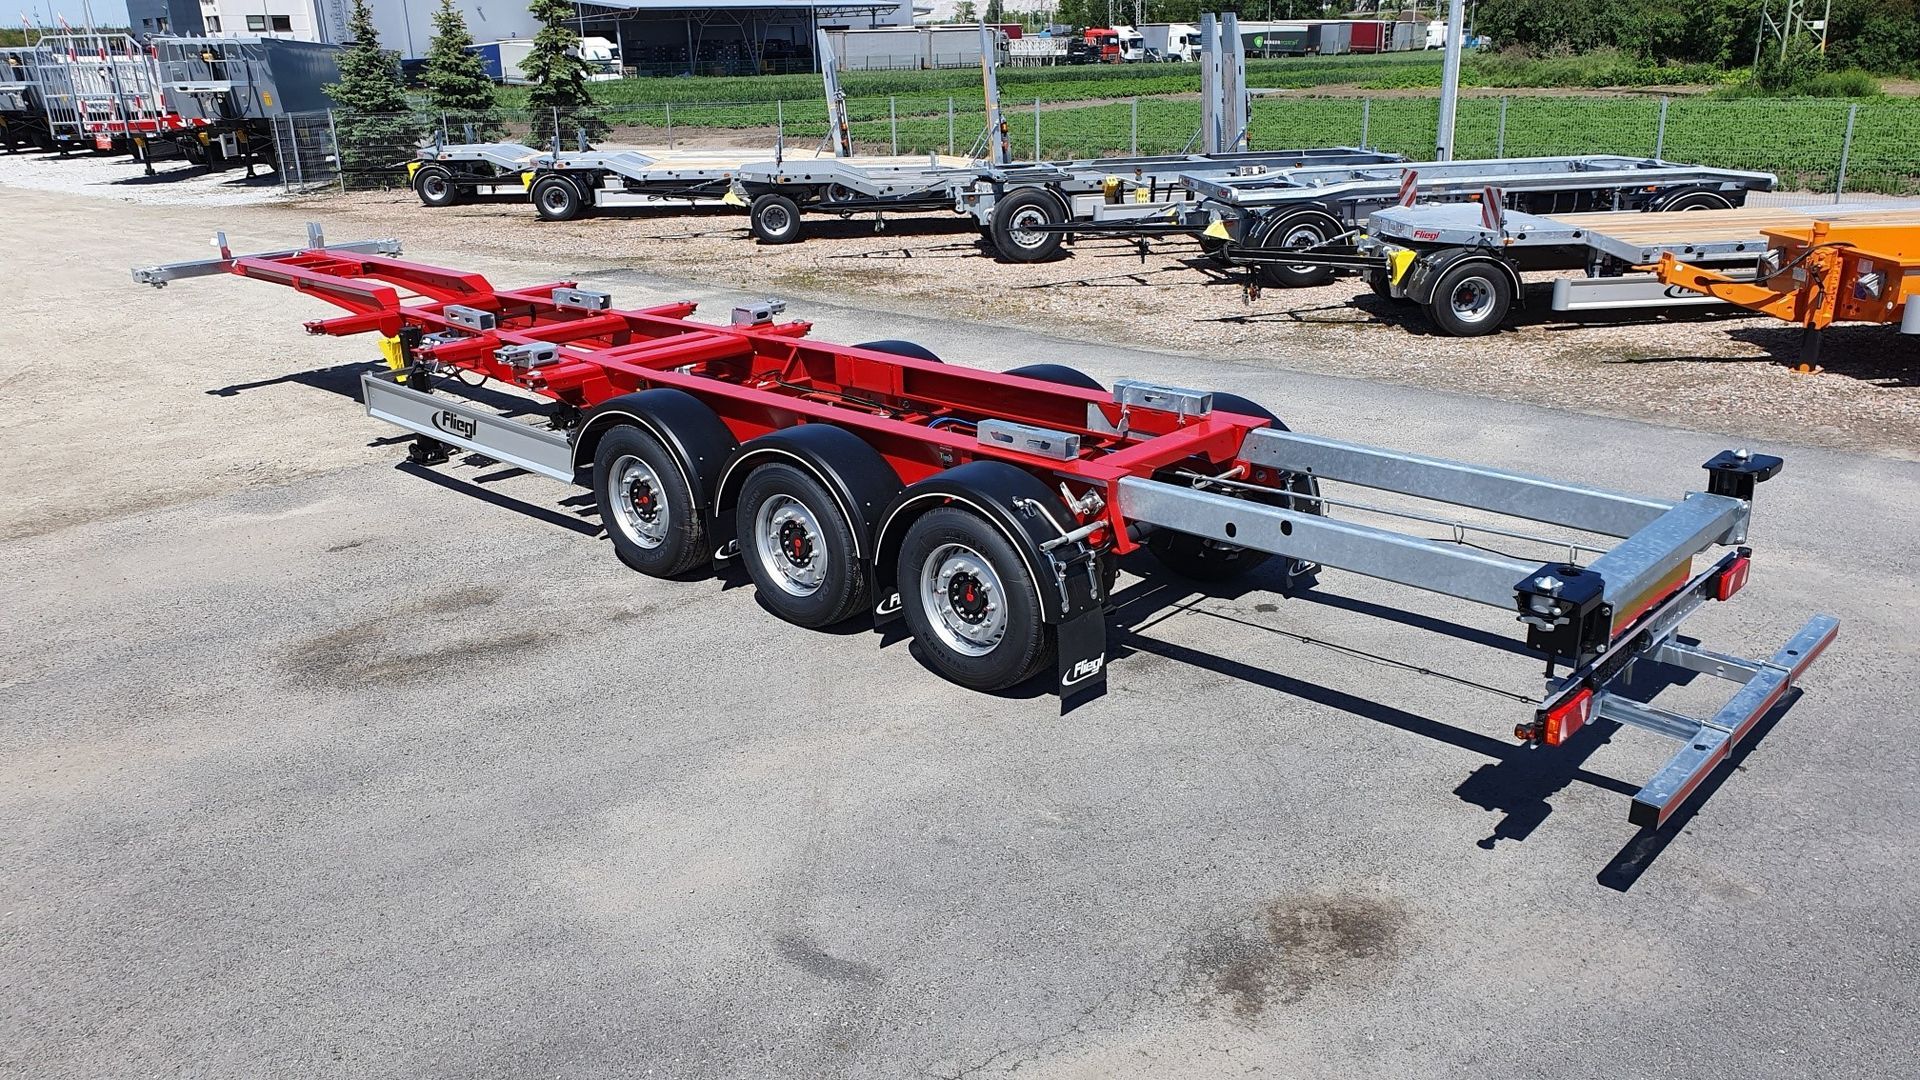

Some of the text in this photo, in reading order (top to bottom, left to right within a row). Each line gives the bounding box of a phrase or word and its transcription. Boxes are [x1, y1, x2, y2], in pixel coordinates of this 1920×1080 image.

[1414, 230, 1440, 241] Fliegl
[442, 410, 477, 439] Fliegl
[1073, 652, 1105, 678] Fliegl
